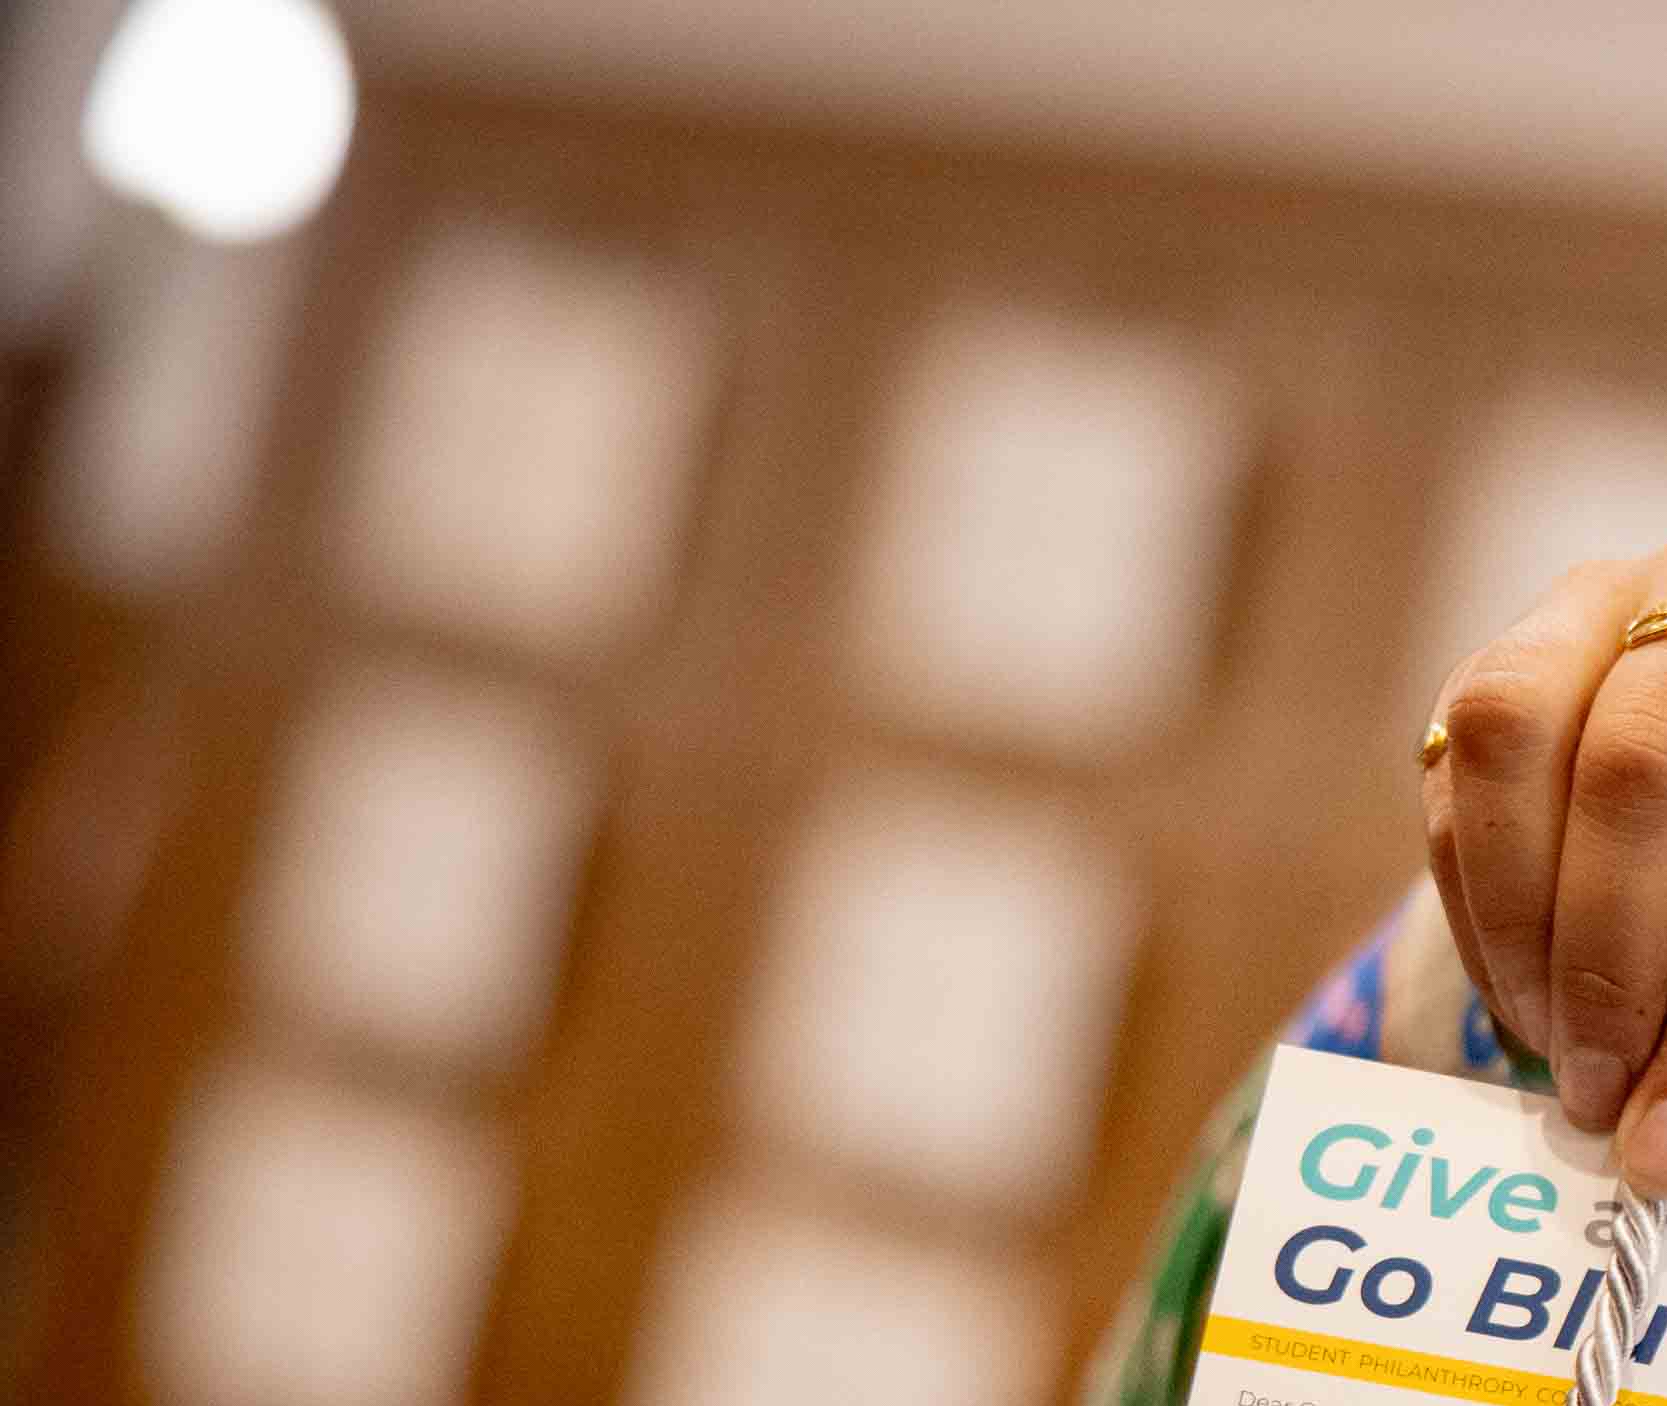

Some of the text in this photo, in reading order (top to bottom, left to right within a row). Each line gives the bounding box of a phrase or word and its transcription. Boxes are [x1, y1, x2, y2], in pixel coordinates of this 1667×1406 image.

[1298, 1123, 1558, 1233] Give
[1273, 1224, 1433, 1319] Go
[1247, 1333, 1351, 1365] STUDENT
[1358, 1353, 1528, 1400] PHILANTHROPY
